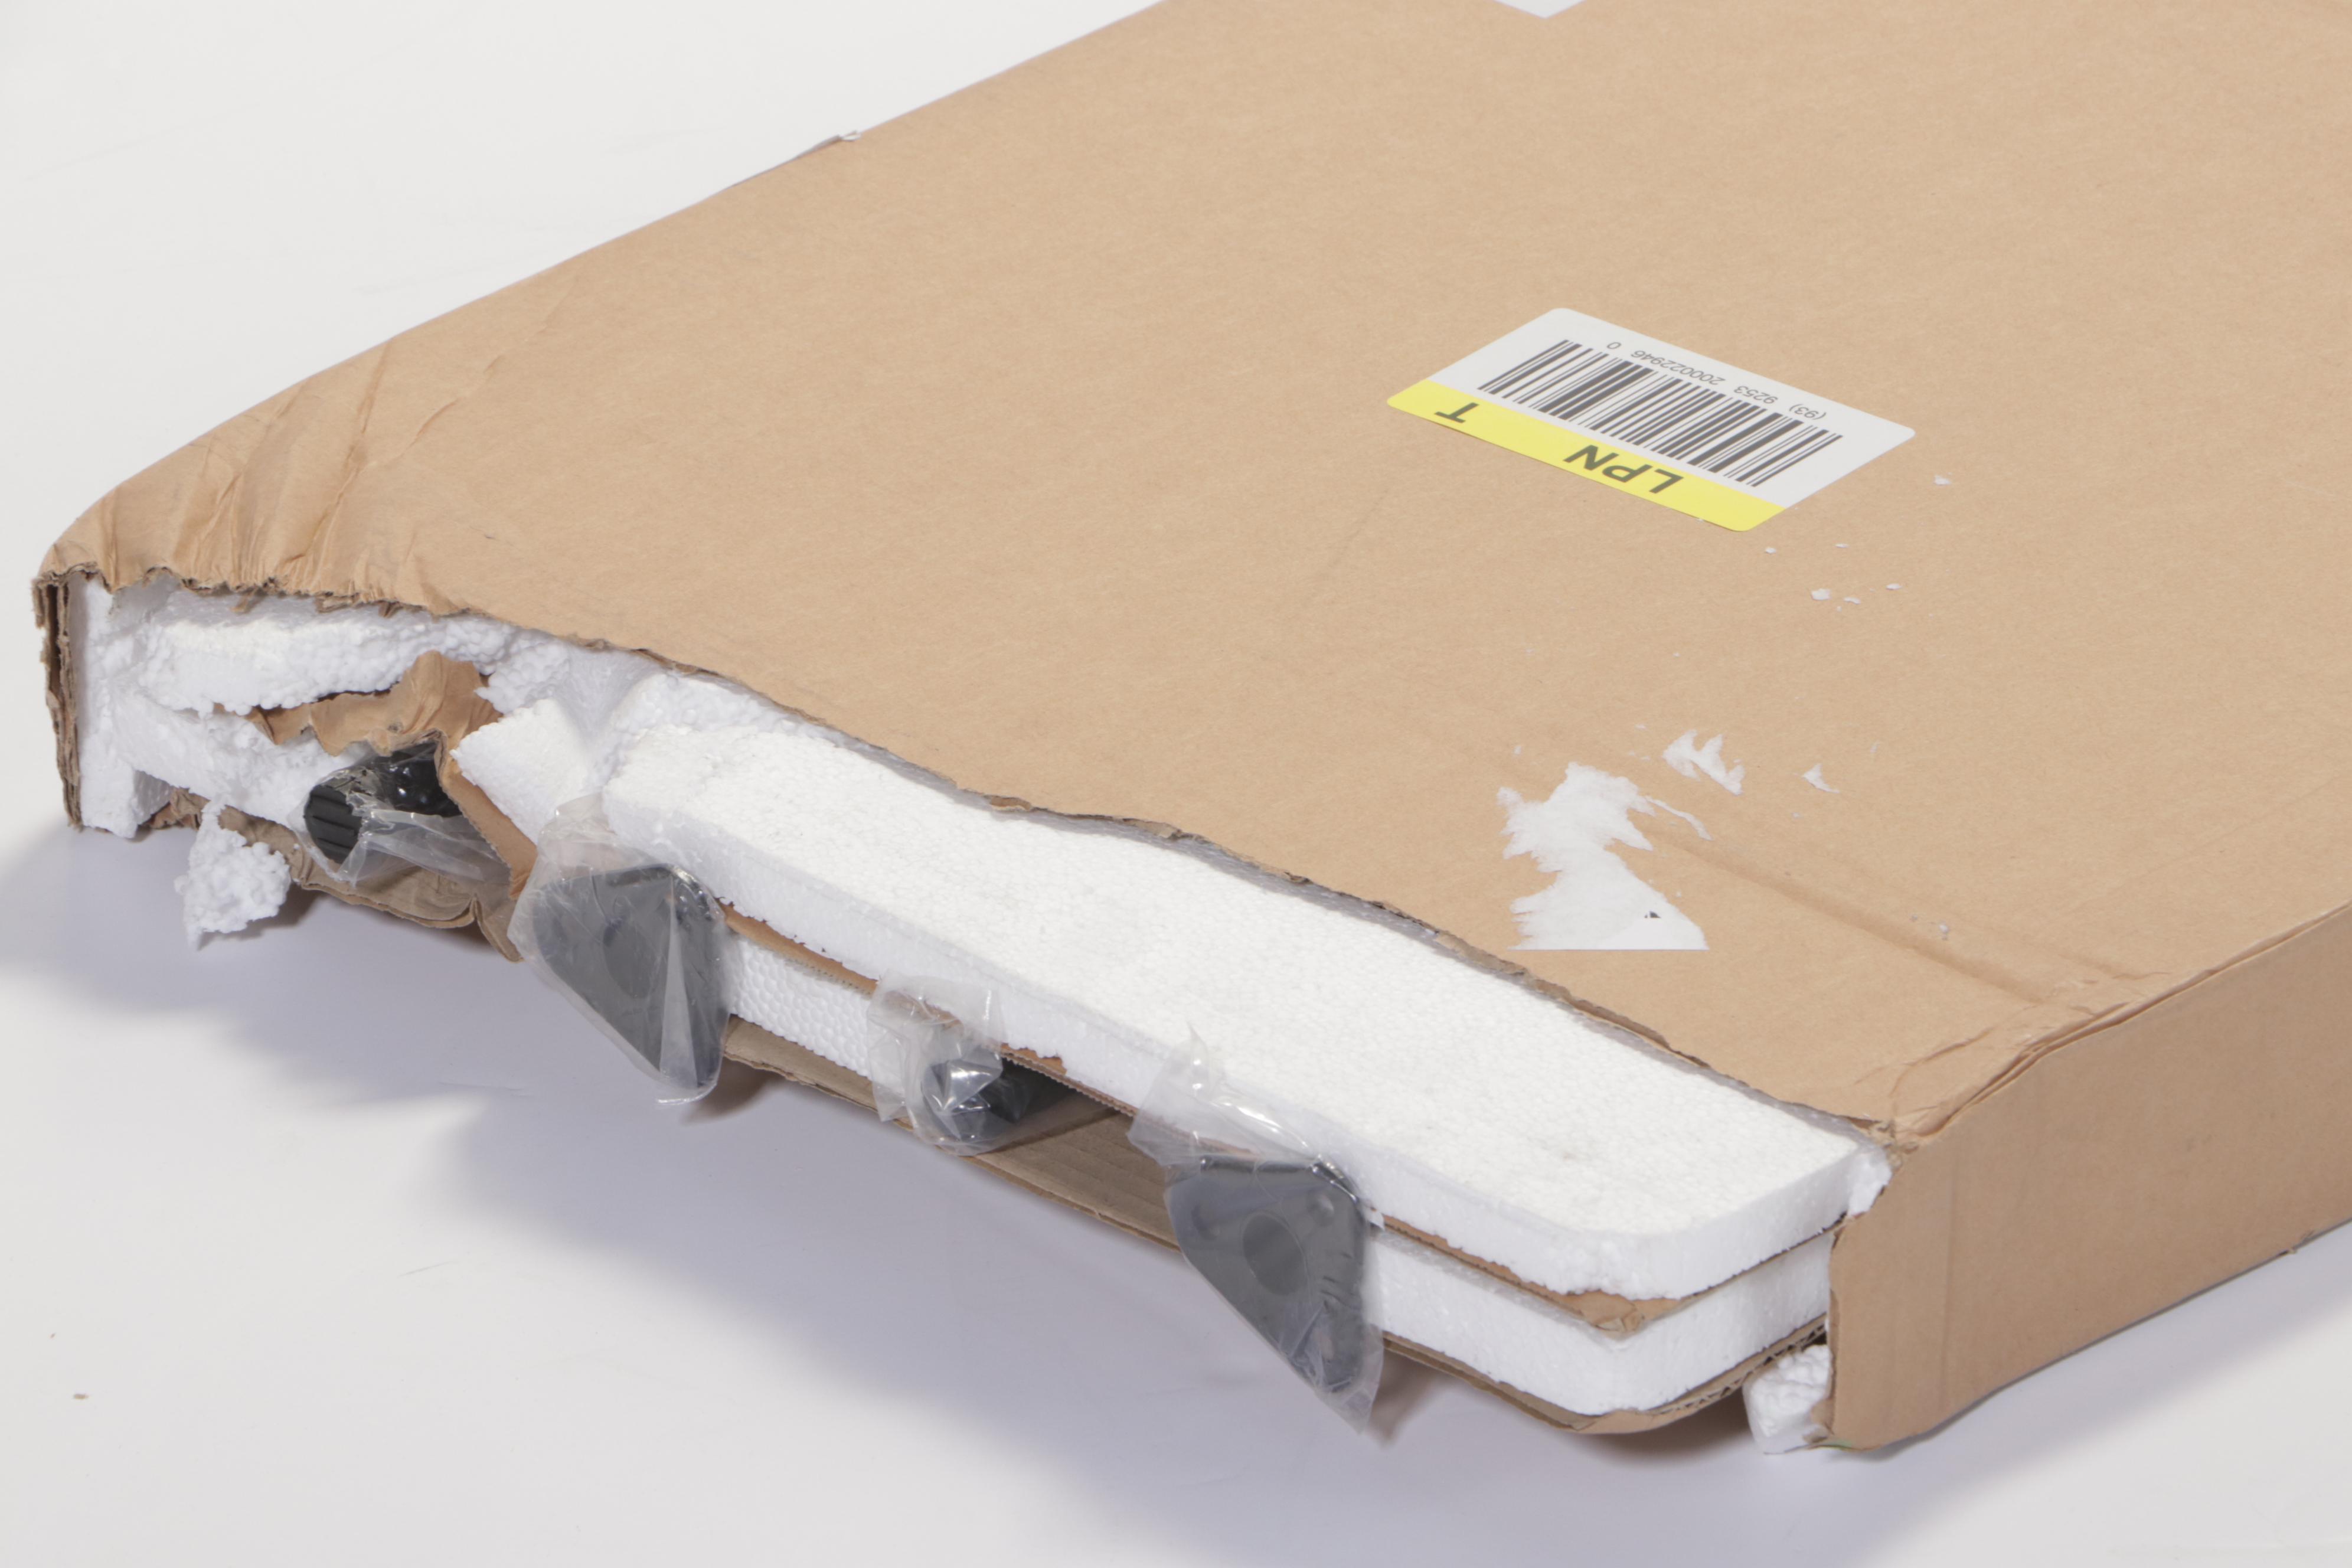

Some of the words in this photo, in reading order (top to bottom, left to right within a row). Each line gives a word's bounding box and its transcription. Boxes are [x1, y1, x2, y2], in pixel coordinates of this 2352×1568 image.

[1606, 341, 1622, 350] 0
[1630, 349, 1726, 386] 200022946
[1733, 386, 1779, 404] 9253
[1433, 402, 1480, 424] T
[1788, 403, 1827, 420] (93)
[1562, 444, 1684, 494] LPN
